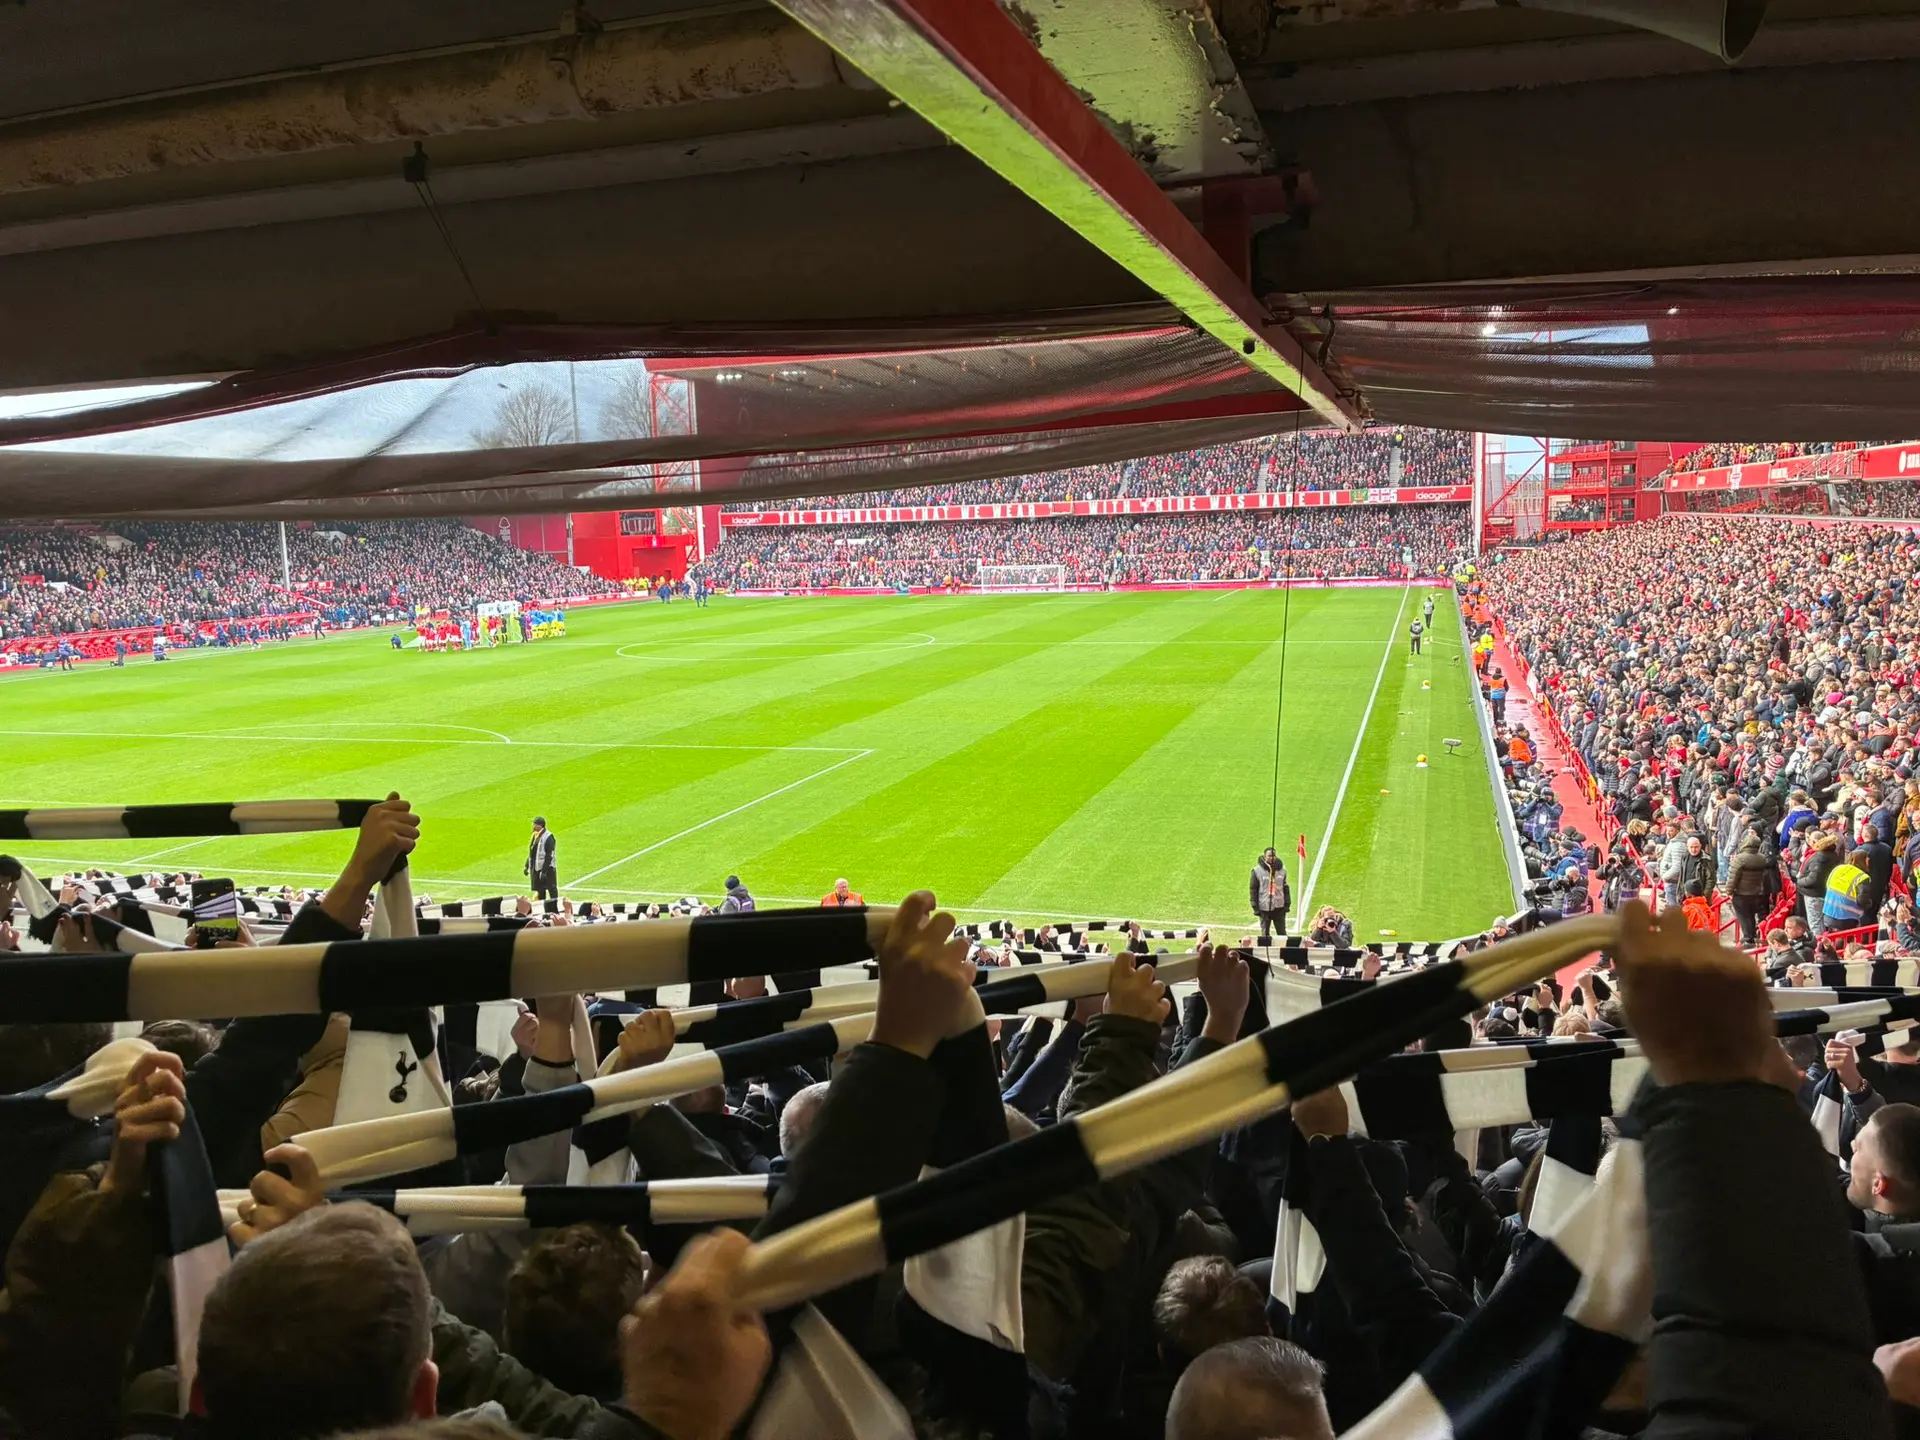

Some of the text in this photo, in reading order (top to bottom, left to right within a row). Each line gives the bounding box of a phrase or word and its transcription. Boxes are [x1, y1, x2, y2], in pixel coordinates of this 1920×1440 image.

[779, 511, 805, 525] THE
[911, 506, 949, 521] THAT
[961, 504, 980, 519] WE
[993, 502, 1035, 518] WEAR
[1088, 500, 1131, 515] WITH
[1210, 494, 1245, 510] WAS
[1258, 492, 1306, 508] MADE
[1320, 491, 1337, 505] IN
